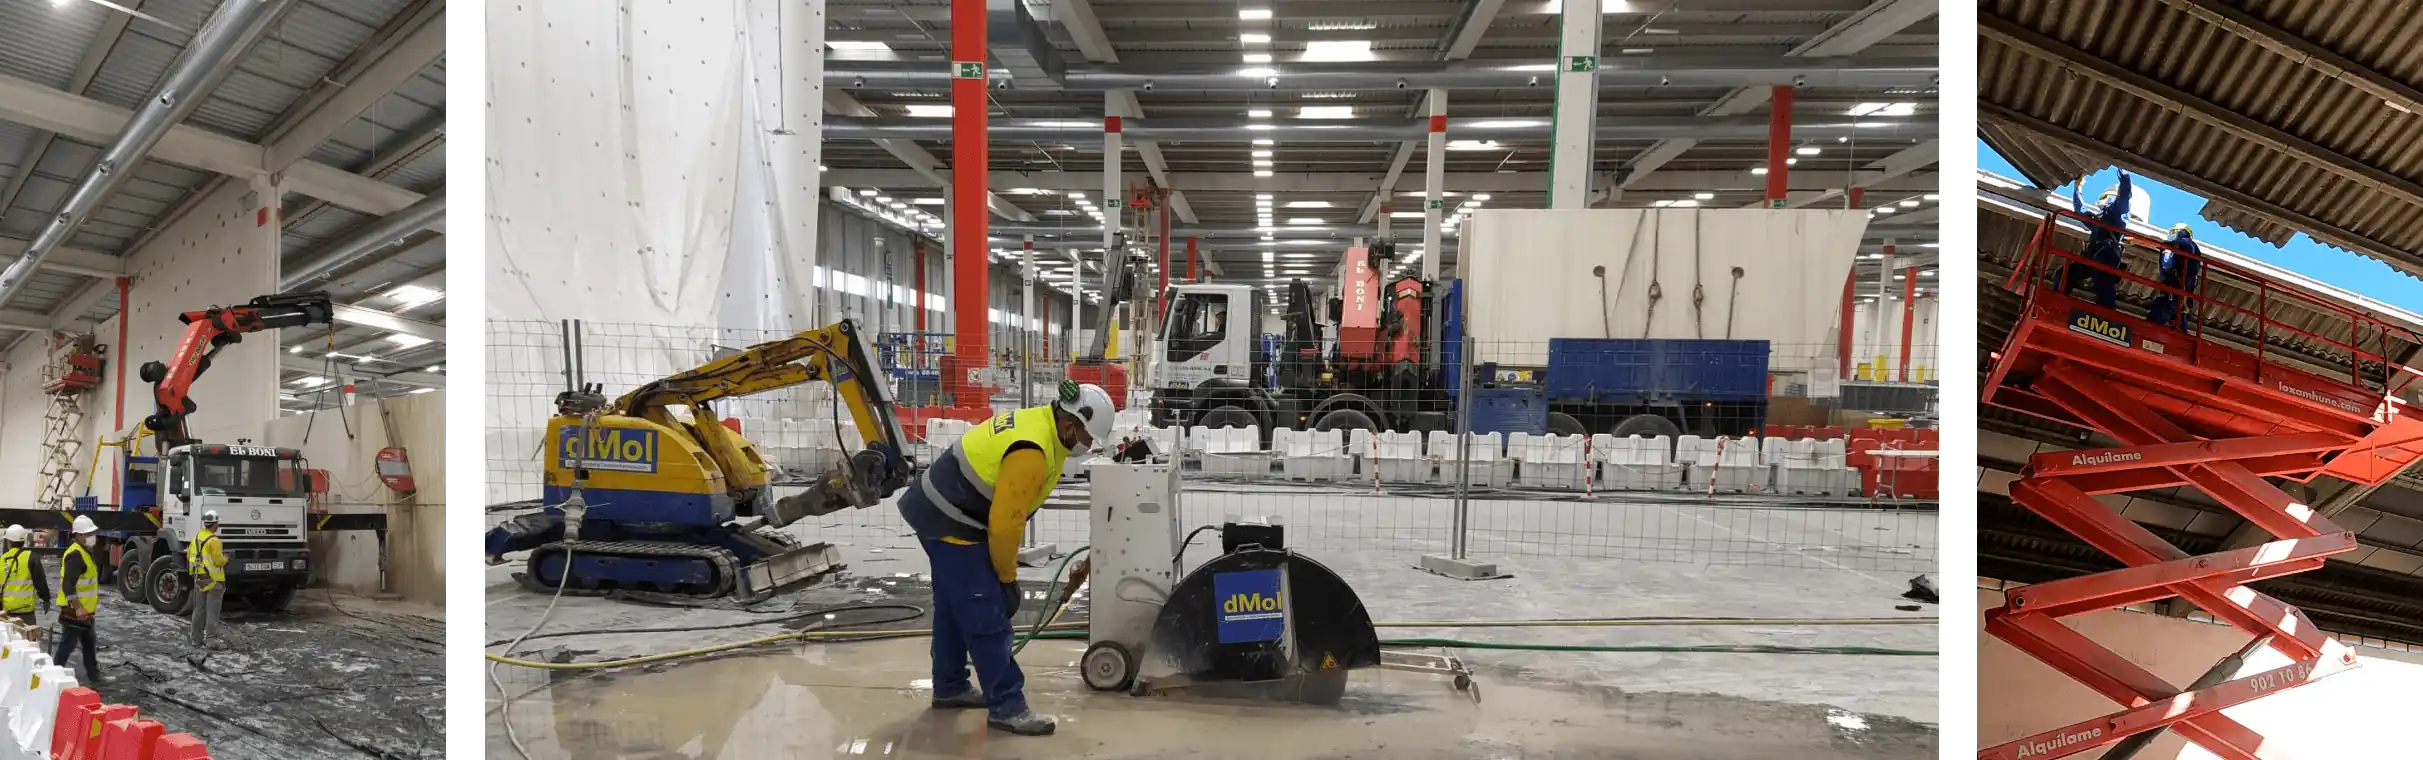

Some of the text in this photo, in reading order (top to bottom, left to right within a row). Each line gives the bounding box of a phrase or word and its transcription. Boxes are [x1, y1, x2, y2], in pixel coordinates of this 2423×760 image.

[2077, 314, 2127, 341] dMol
[2278, 381, 2361, 413] loxamhune.com
[248, 447, 276, 457] BONI
[565, 428, 653, 462] dMol
[1223, 592, 1283, 613] dMol
[2250, 674, 2276, 693] 902
[2278, 668, 2294, 685] 10
